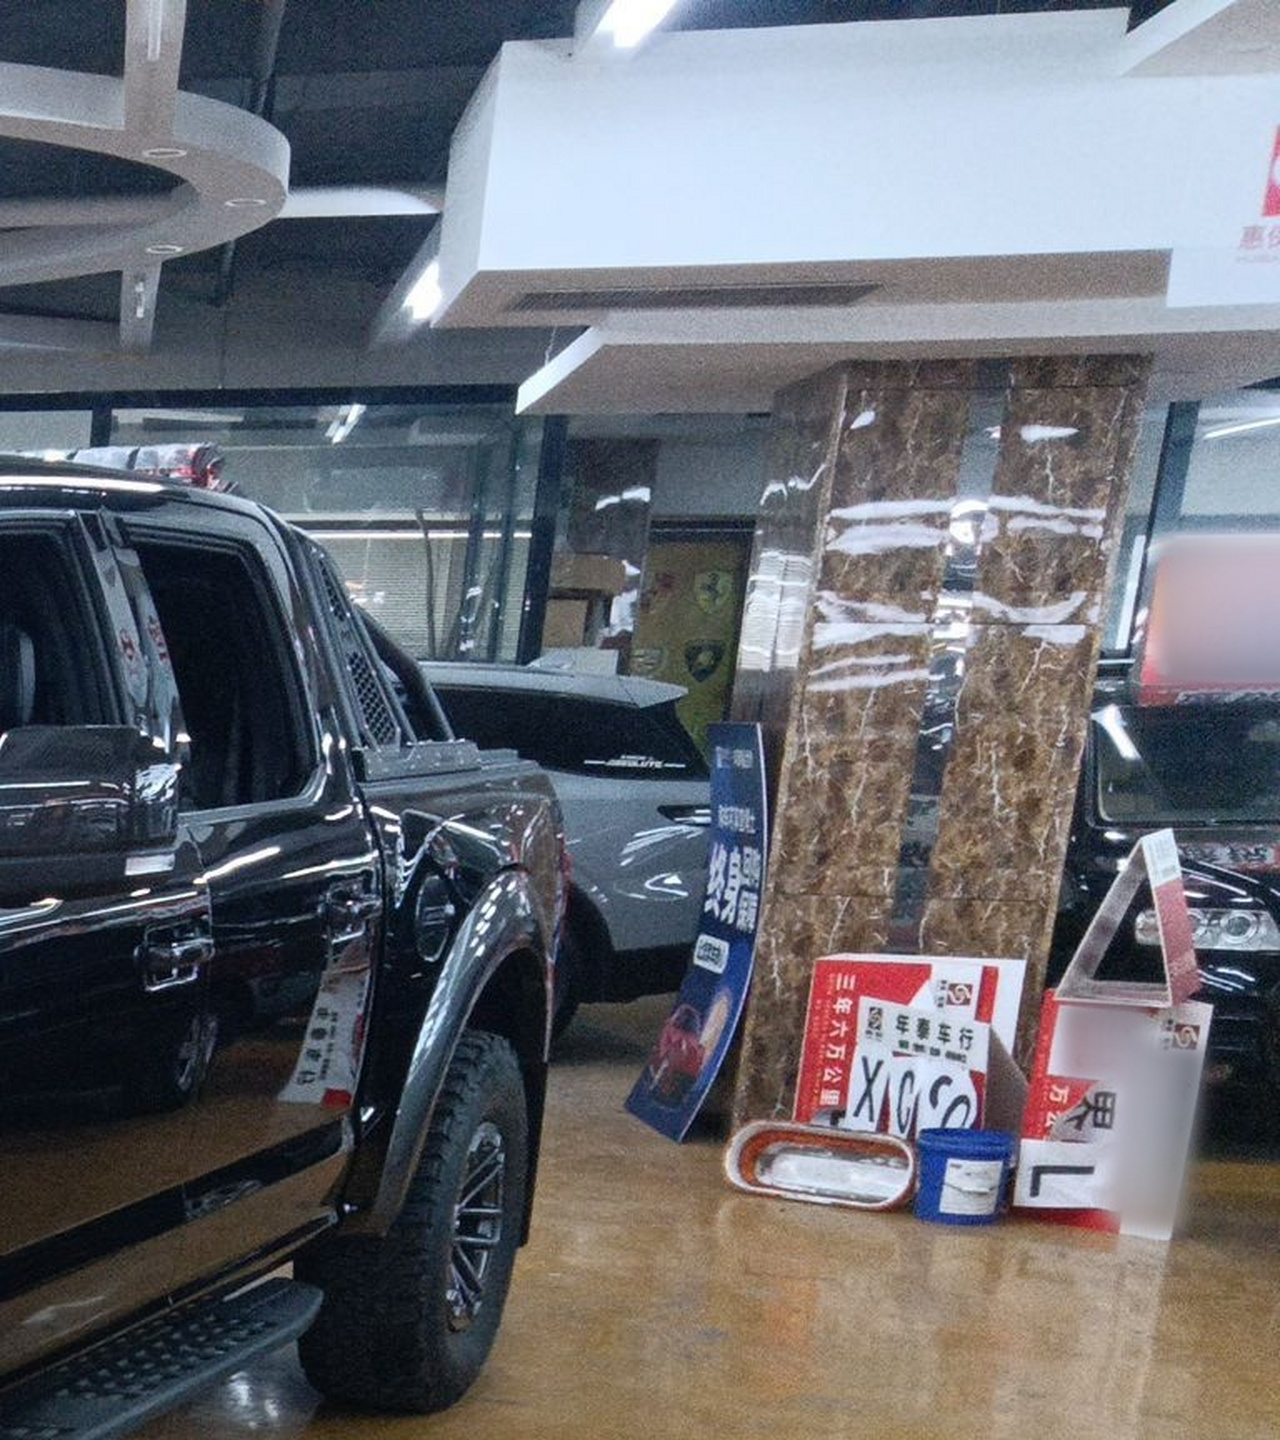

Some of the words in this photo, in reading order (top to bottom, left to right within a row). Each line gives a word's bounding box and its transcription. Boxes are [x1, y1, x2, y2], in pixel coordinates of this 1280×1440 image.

[819, 973, 856, 1106] 三年六万公里
[895, 1014, 974, 1051] 年泰车行
